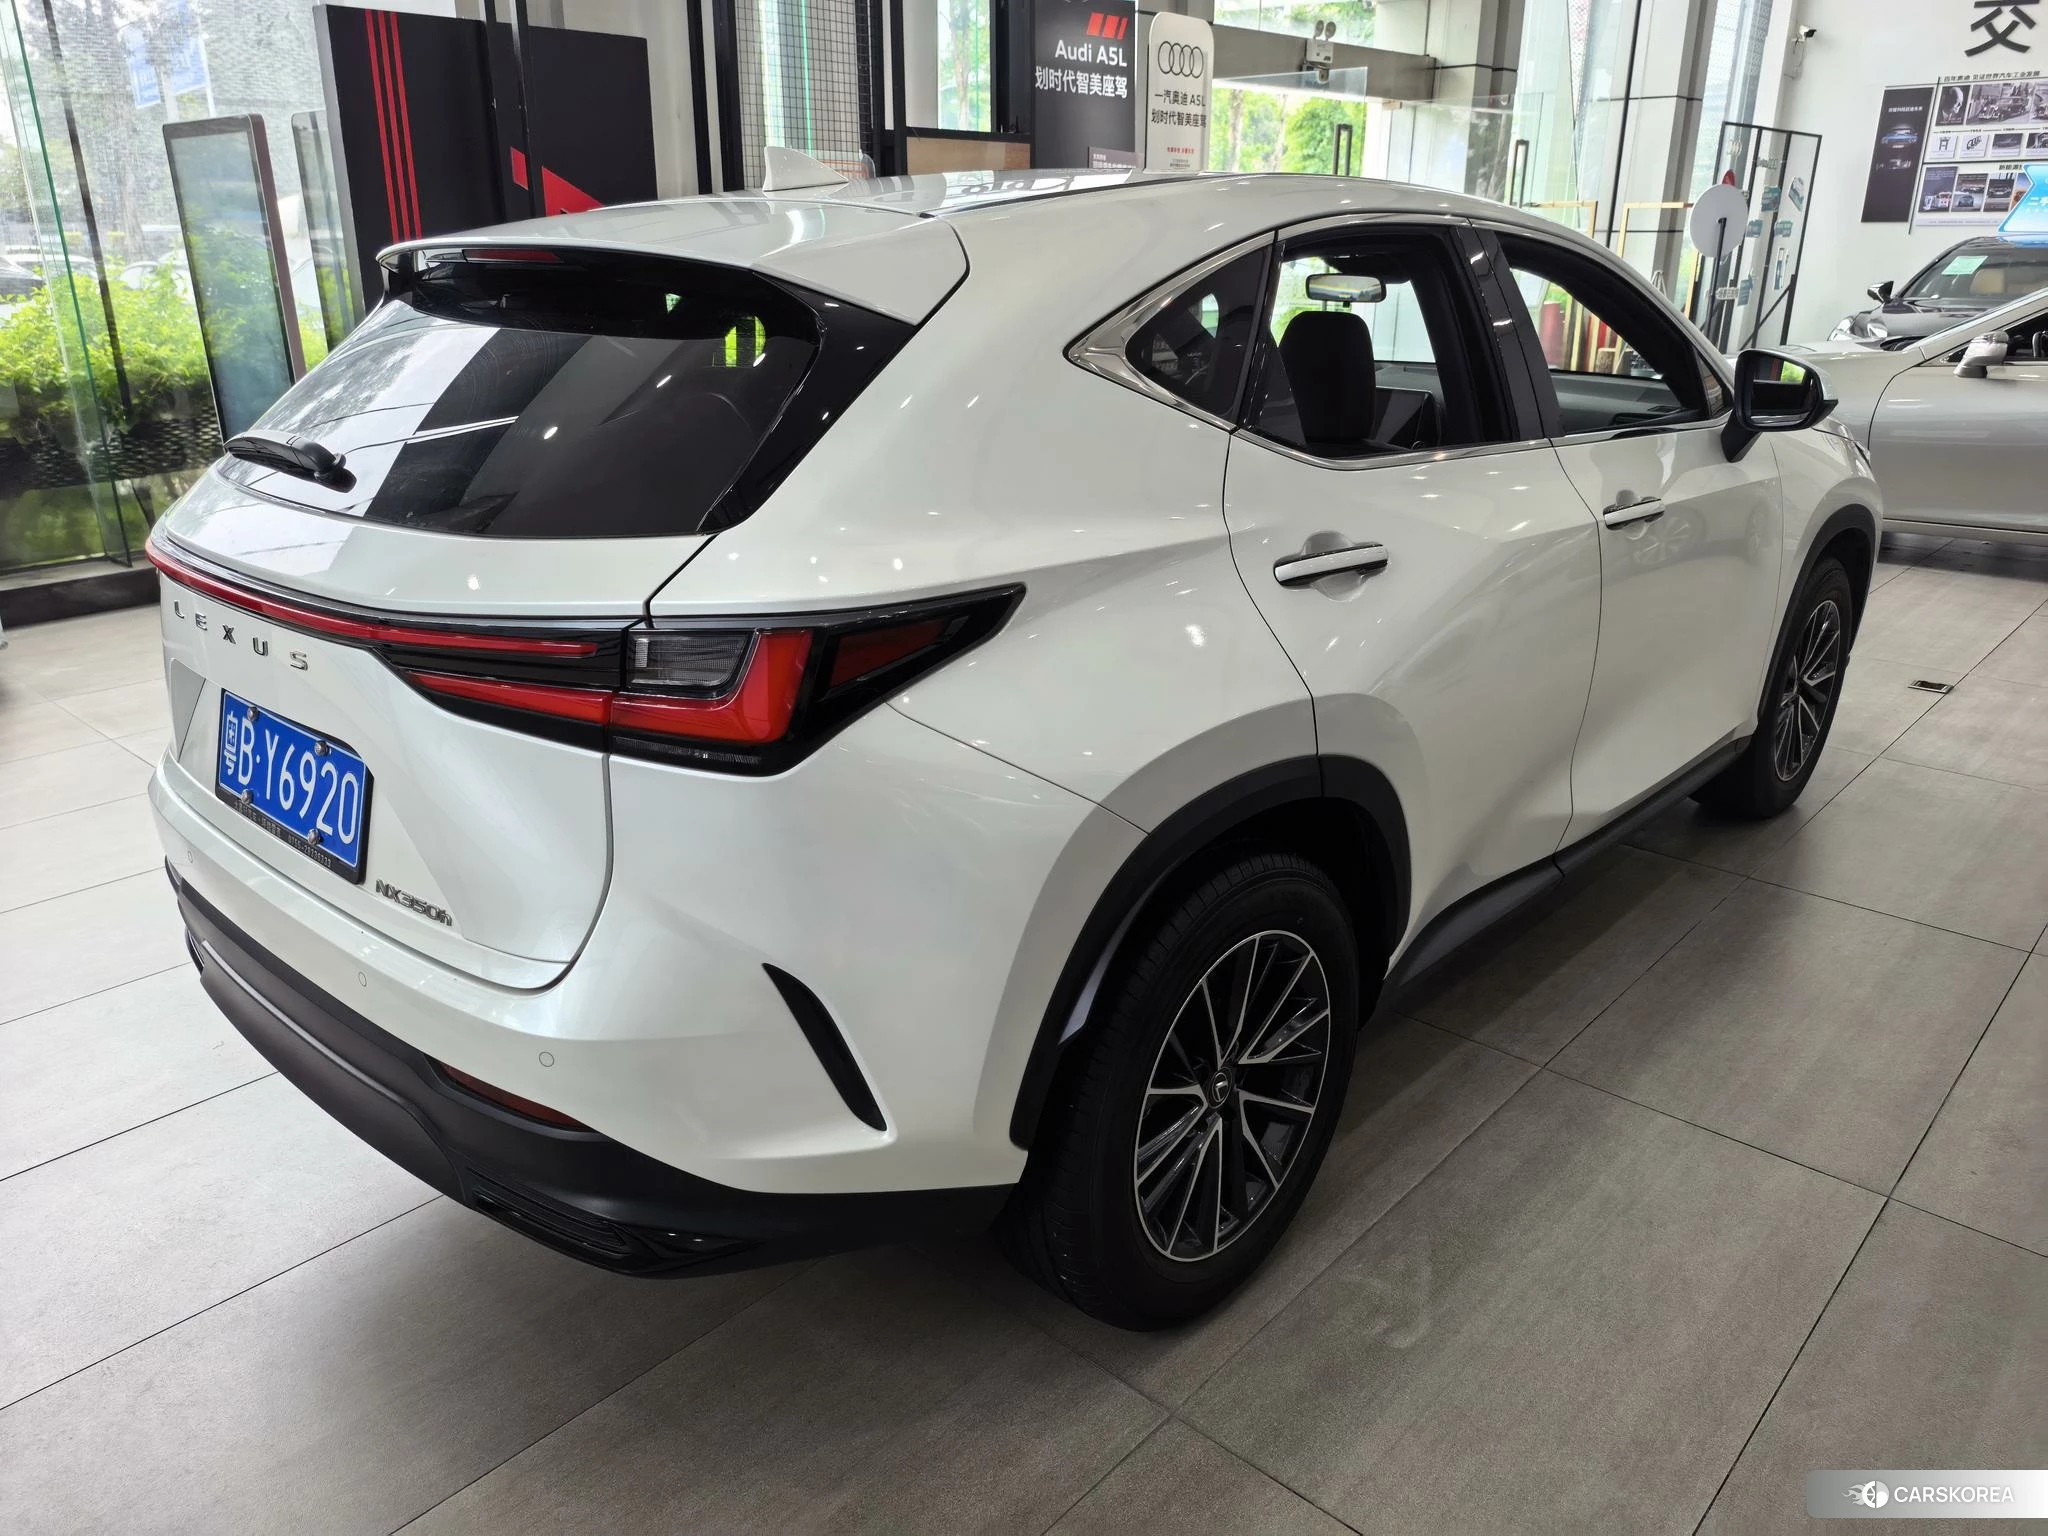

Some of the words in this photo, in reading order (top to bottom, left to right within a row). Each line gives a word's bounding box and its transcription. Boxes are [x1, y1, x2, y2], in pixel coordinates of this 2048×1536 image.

[1964, 0, 2040, 57] 交
[1055, 40, 1092, 62] Audi
[1096, 45, 1128, 67] A5L
[1035, 65, 1128, 99] 划时代智美座驾
[1154, 89, 1188, 106] 一汽奥迪
[1151, 108, 1207, 128] 划时代智美座驾
[174, 600, 309, 671] LEXUS
[376, 879, 452, 927] NX350h
